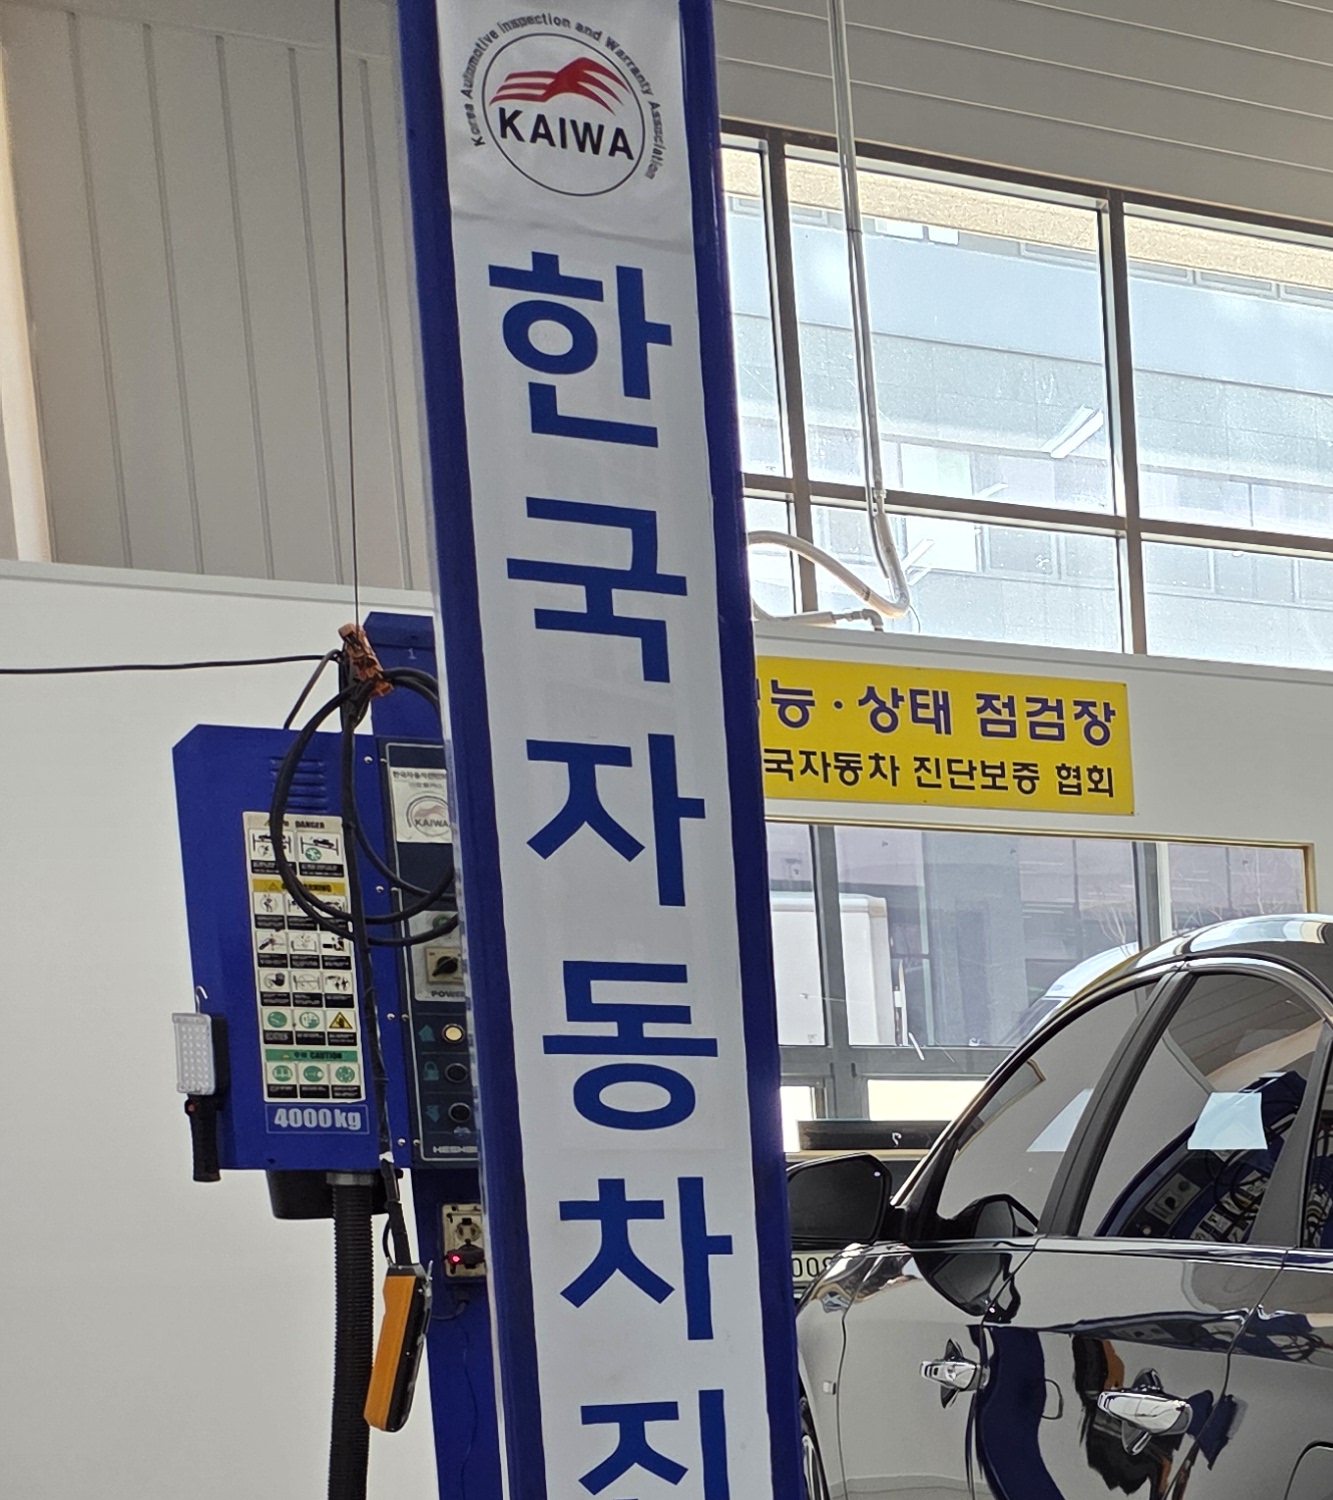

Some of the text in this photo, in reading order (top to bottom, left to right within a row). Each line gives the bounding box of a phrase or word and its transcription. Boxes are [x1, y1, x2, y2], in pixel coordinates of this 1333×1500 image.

[460, 28, 500, 98] Automotive
[498, 12, 571, 34] Inspection
[574, 21, 602, 42] and
[605, 35, 653, 97] Warranty
[646, 99, 666, 181] Association
[498, 106, 635, 161] KAIWA
[975, 691, 1117, 747] 점검장
[763, 747, 1114, 798] 국자동차 진단보증 협회
